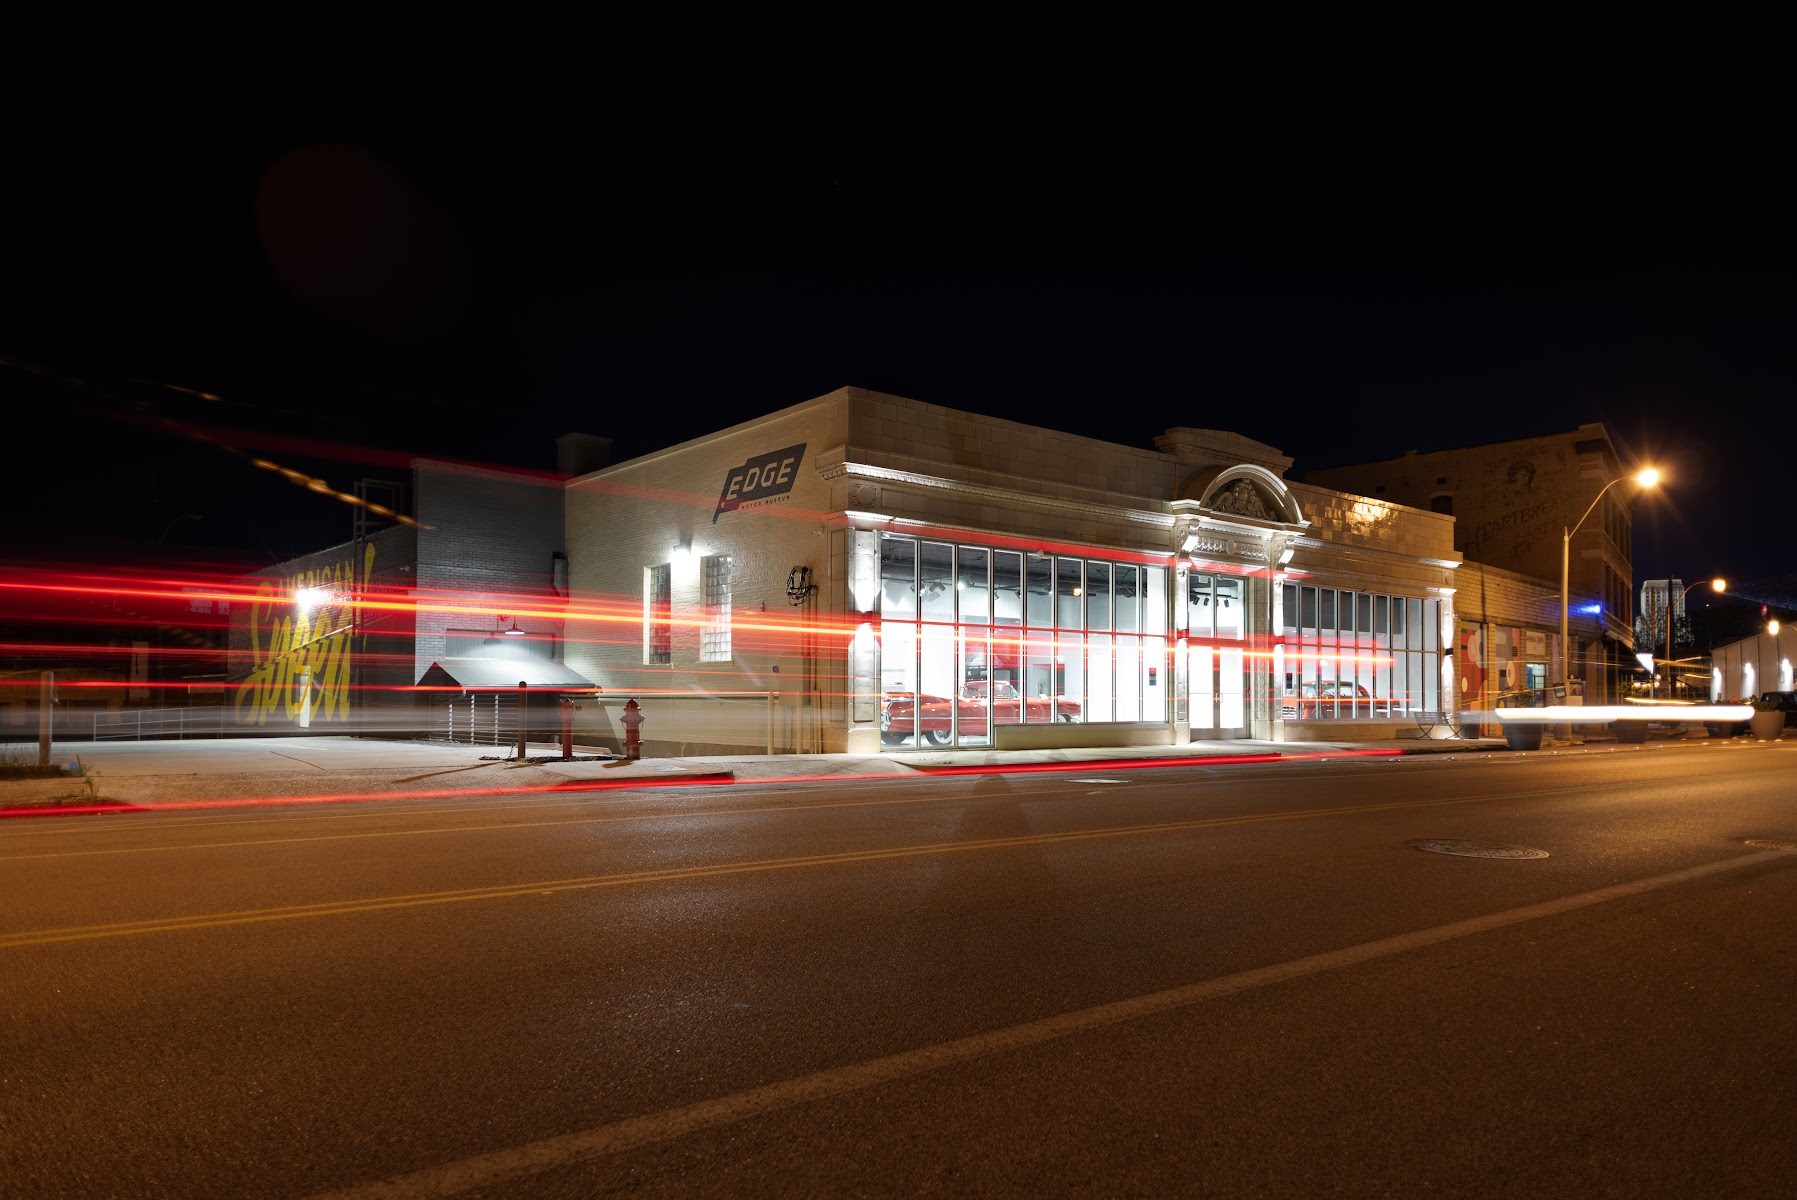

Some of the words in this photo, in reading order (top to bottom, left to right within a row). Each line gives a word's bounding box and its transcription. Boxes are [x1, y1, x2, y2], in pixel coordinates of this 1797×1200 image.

[726, 457, 795, 500] EDGE
[741, 501, 762, 510] MOTOR
[765, 495, 790, 504] MUSEUM
[276, 558, 355, 606] AMERICAN
